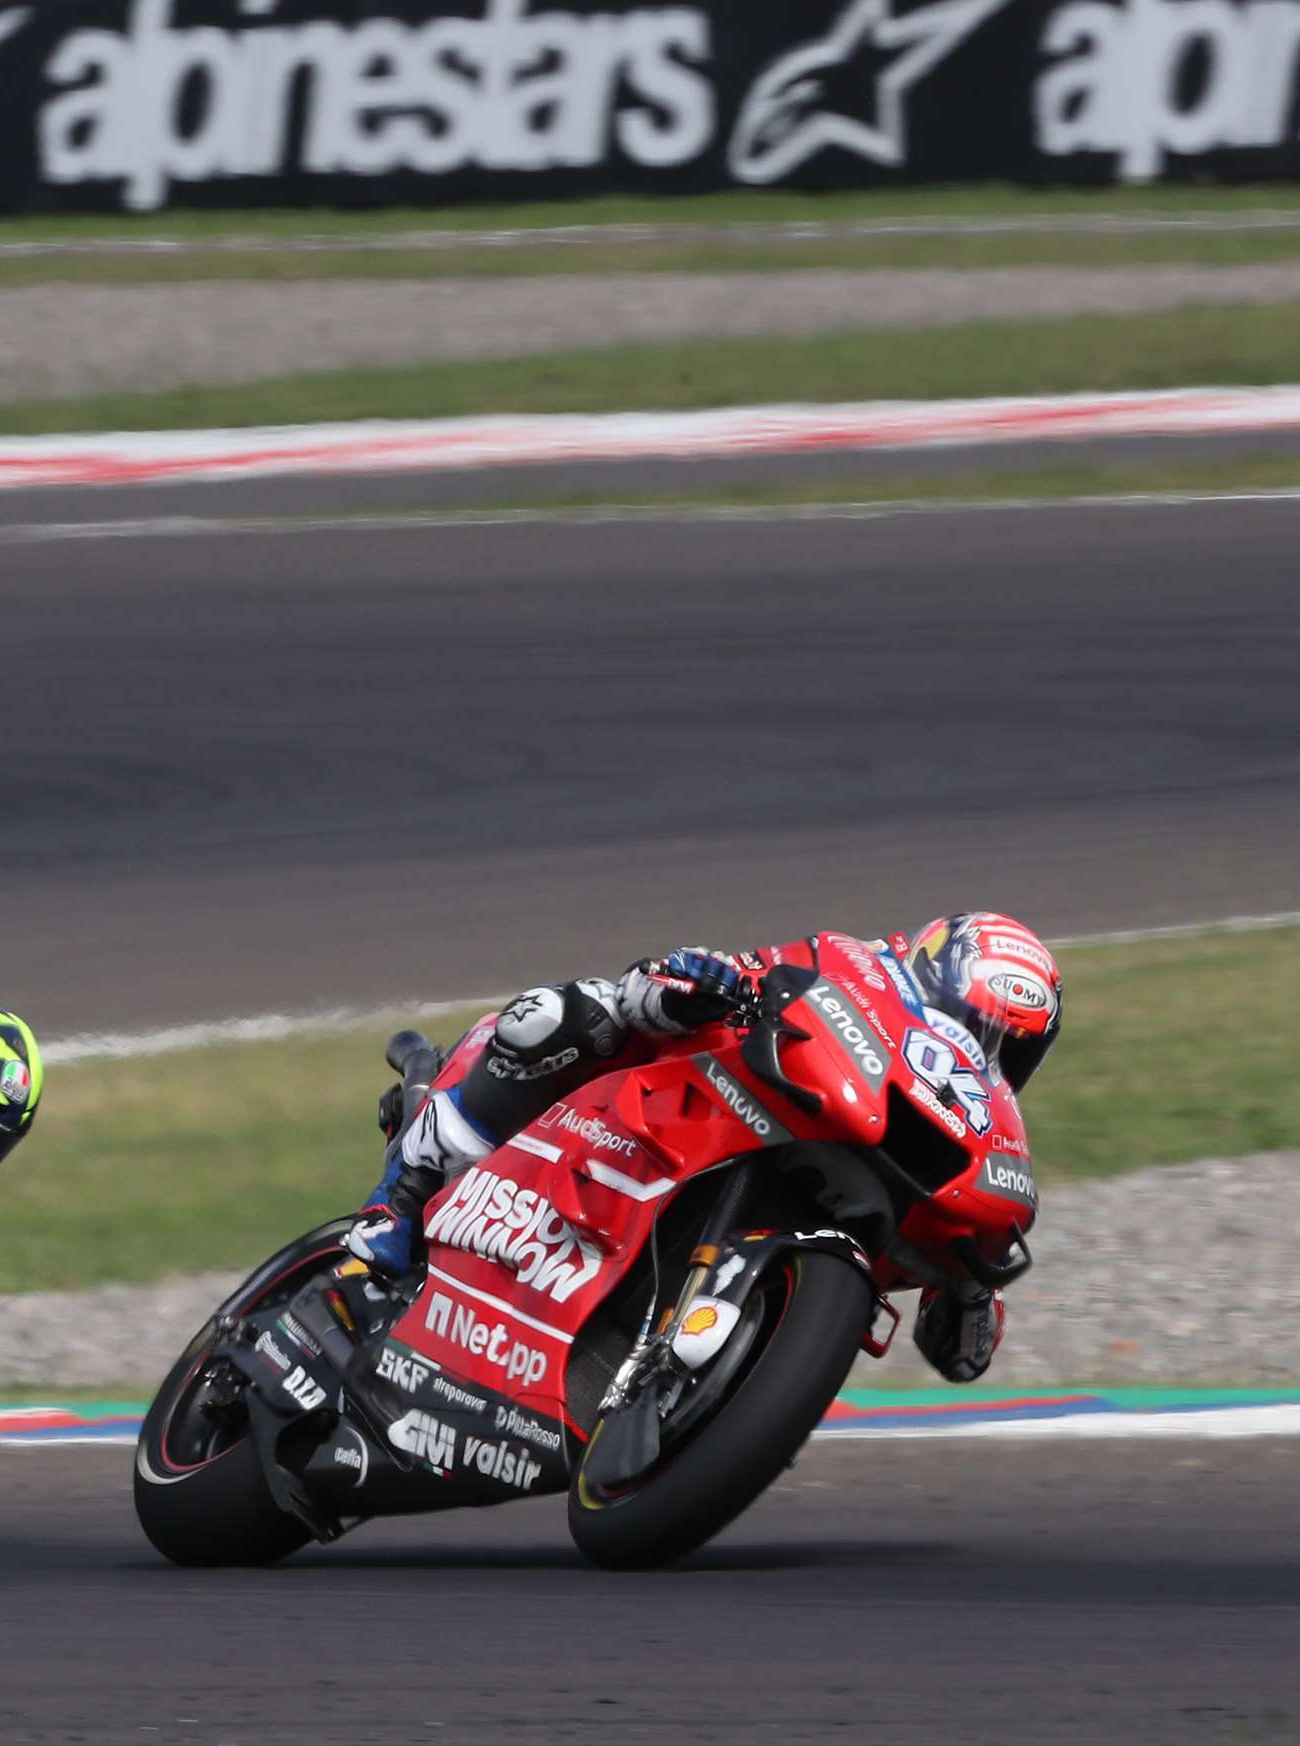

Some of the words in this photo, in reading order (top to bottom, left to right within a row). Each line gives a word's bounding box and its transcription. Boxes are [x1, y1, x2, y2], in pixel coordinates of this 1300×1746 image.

[39, 0, 714, 210] alpinestars
[807, 984, 883, 1075] Lenovo
[707, 1062, 770, 1135] Lenovo
[424, 1206, 604, 1303] WINNOW
[376, 1347, 430, 1394] SKF
[462, 1436, 542, 1491] valsir
